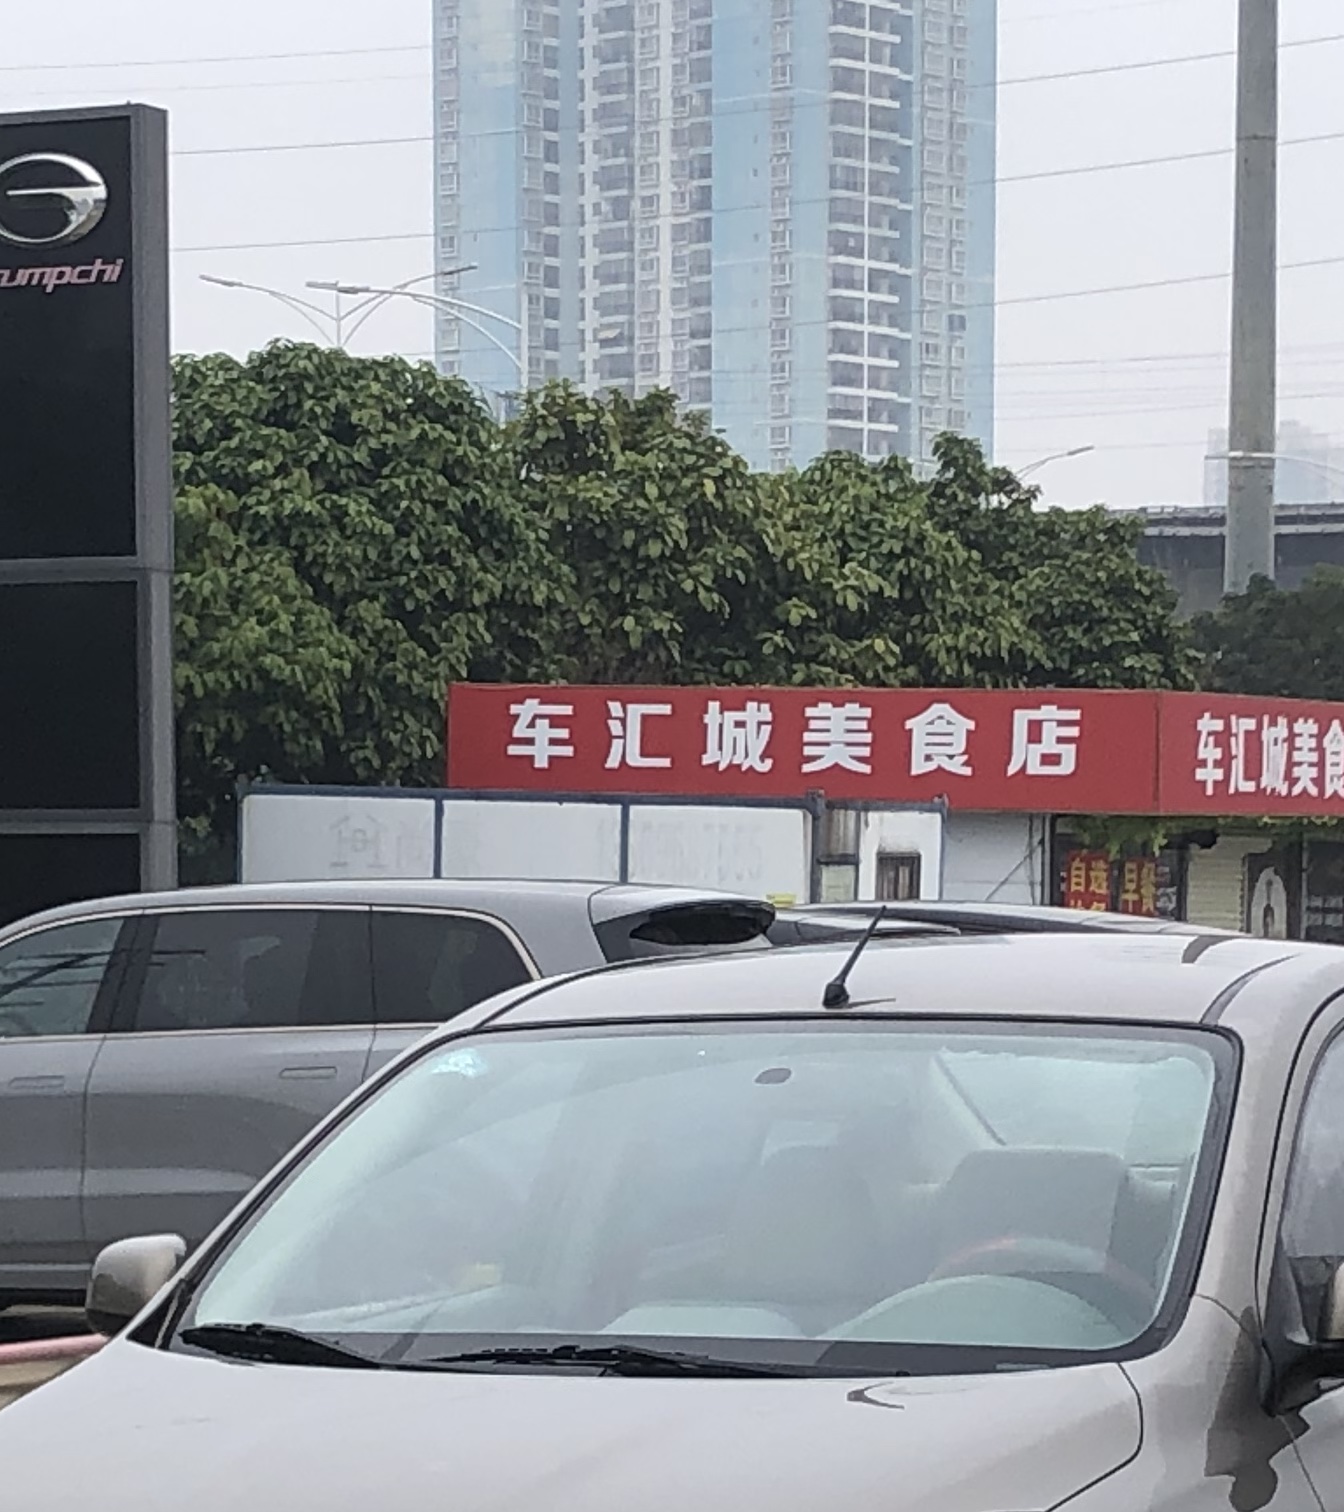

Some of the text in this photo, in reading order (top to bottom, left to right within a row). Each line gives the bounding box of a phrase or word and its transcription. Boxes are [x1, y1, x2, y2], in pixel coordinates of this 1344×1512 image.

[507, 698, 1082, 777] 车汇城美食店
